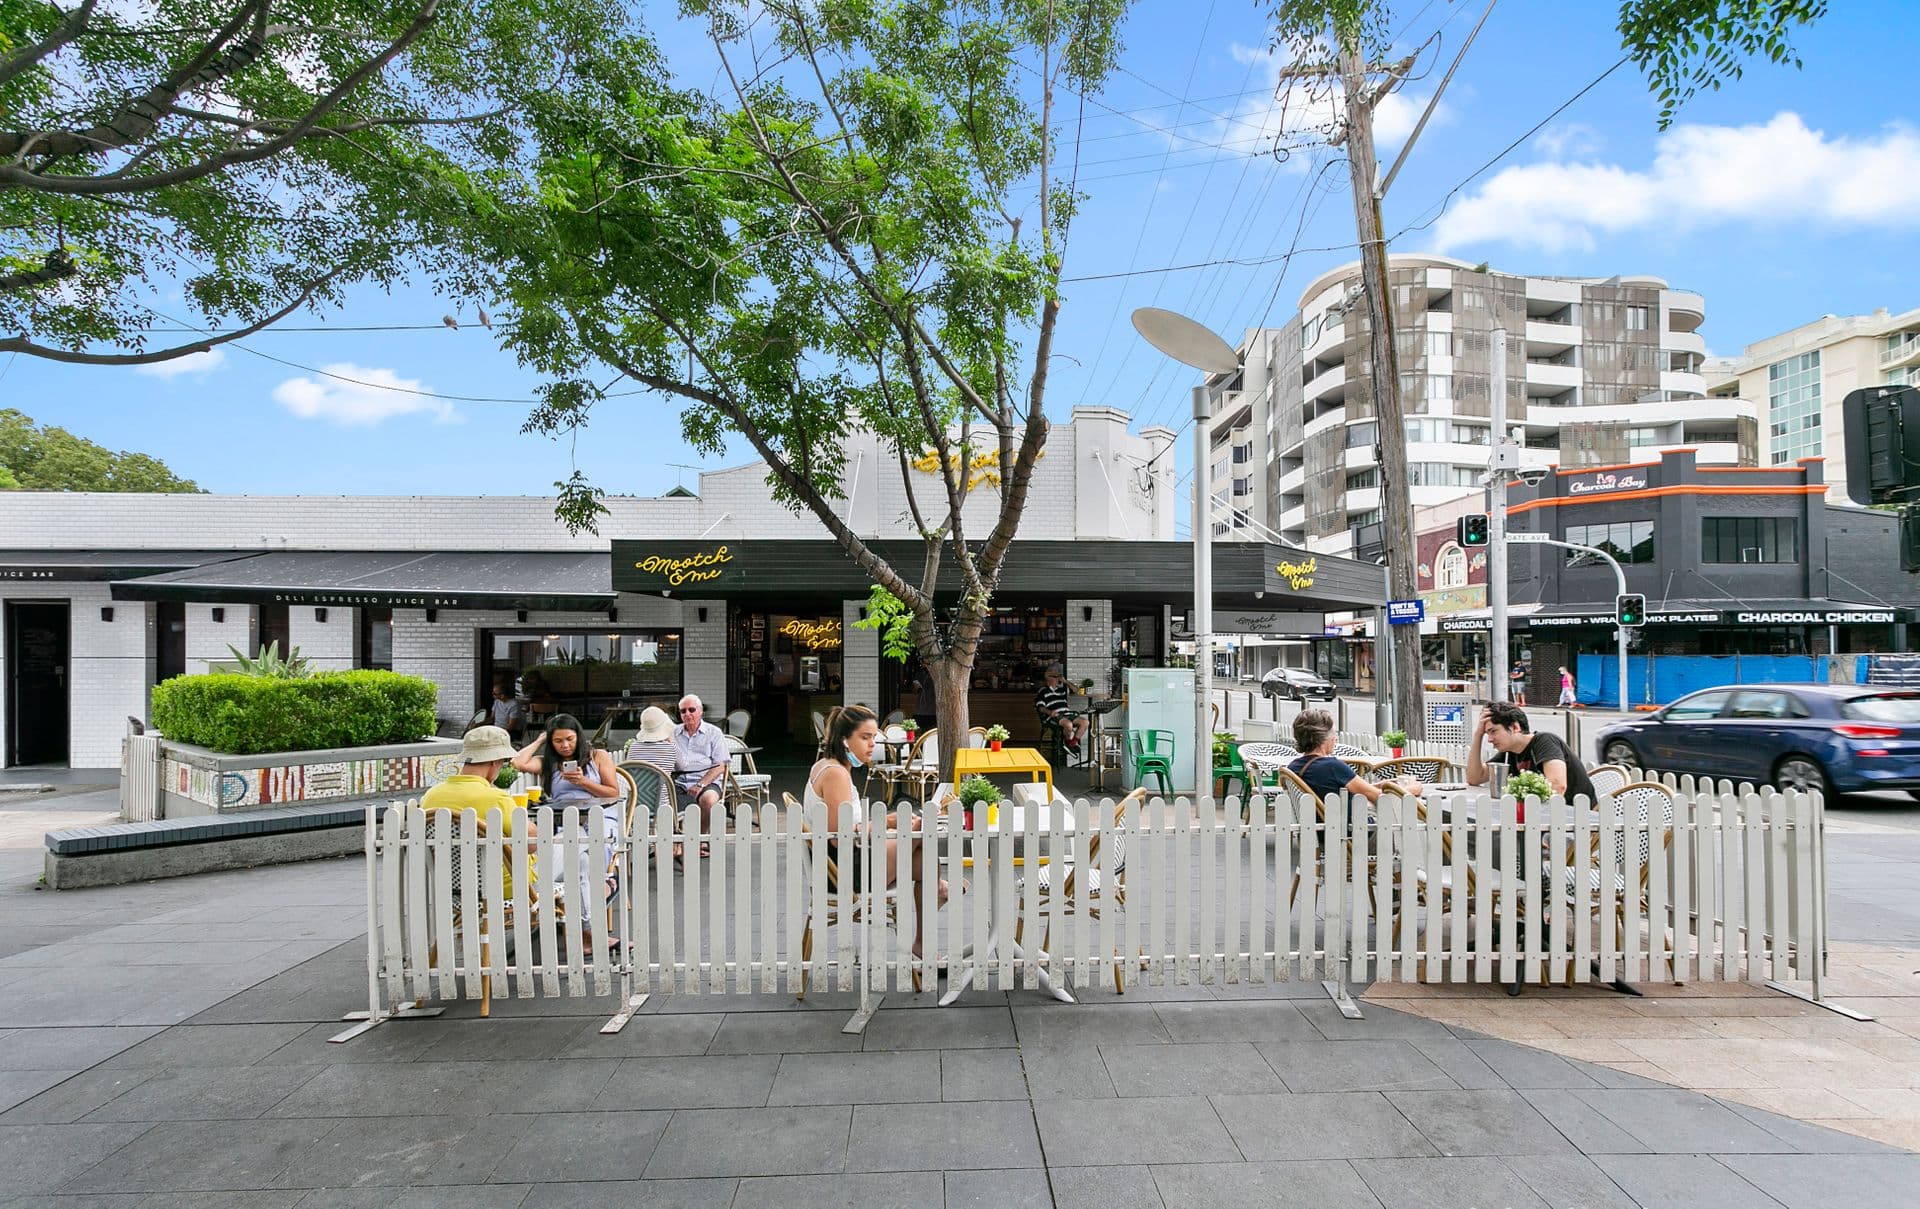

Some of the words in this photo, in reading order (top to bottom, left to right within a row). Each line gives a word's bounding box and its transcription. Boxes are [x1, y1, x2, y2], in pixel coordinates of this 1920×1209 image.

[1570, 480, 1617, 493] Charcoal
[1618, 476, 1646, 488] Bay
[635, 545, 733, 575] Mootch
[314, 595, 378, 603] ESPRESSO
[388, 597, 425, 605] JUICE
[435, 598, 458, 606] BAR
[1529, 618, 1581, 626] BURGERS
[1669, 614, 1718, 622] PLATES
[1737, 612, 1824, 623] CHARCOAL
[1826, 612, 1894, 623] CHICKEN
[1443, 621, 1485, 630] CHARCOAL
